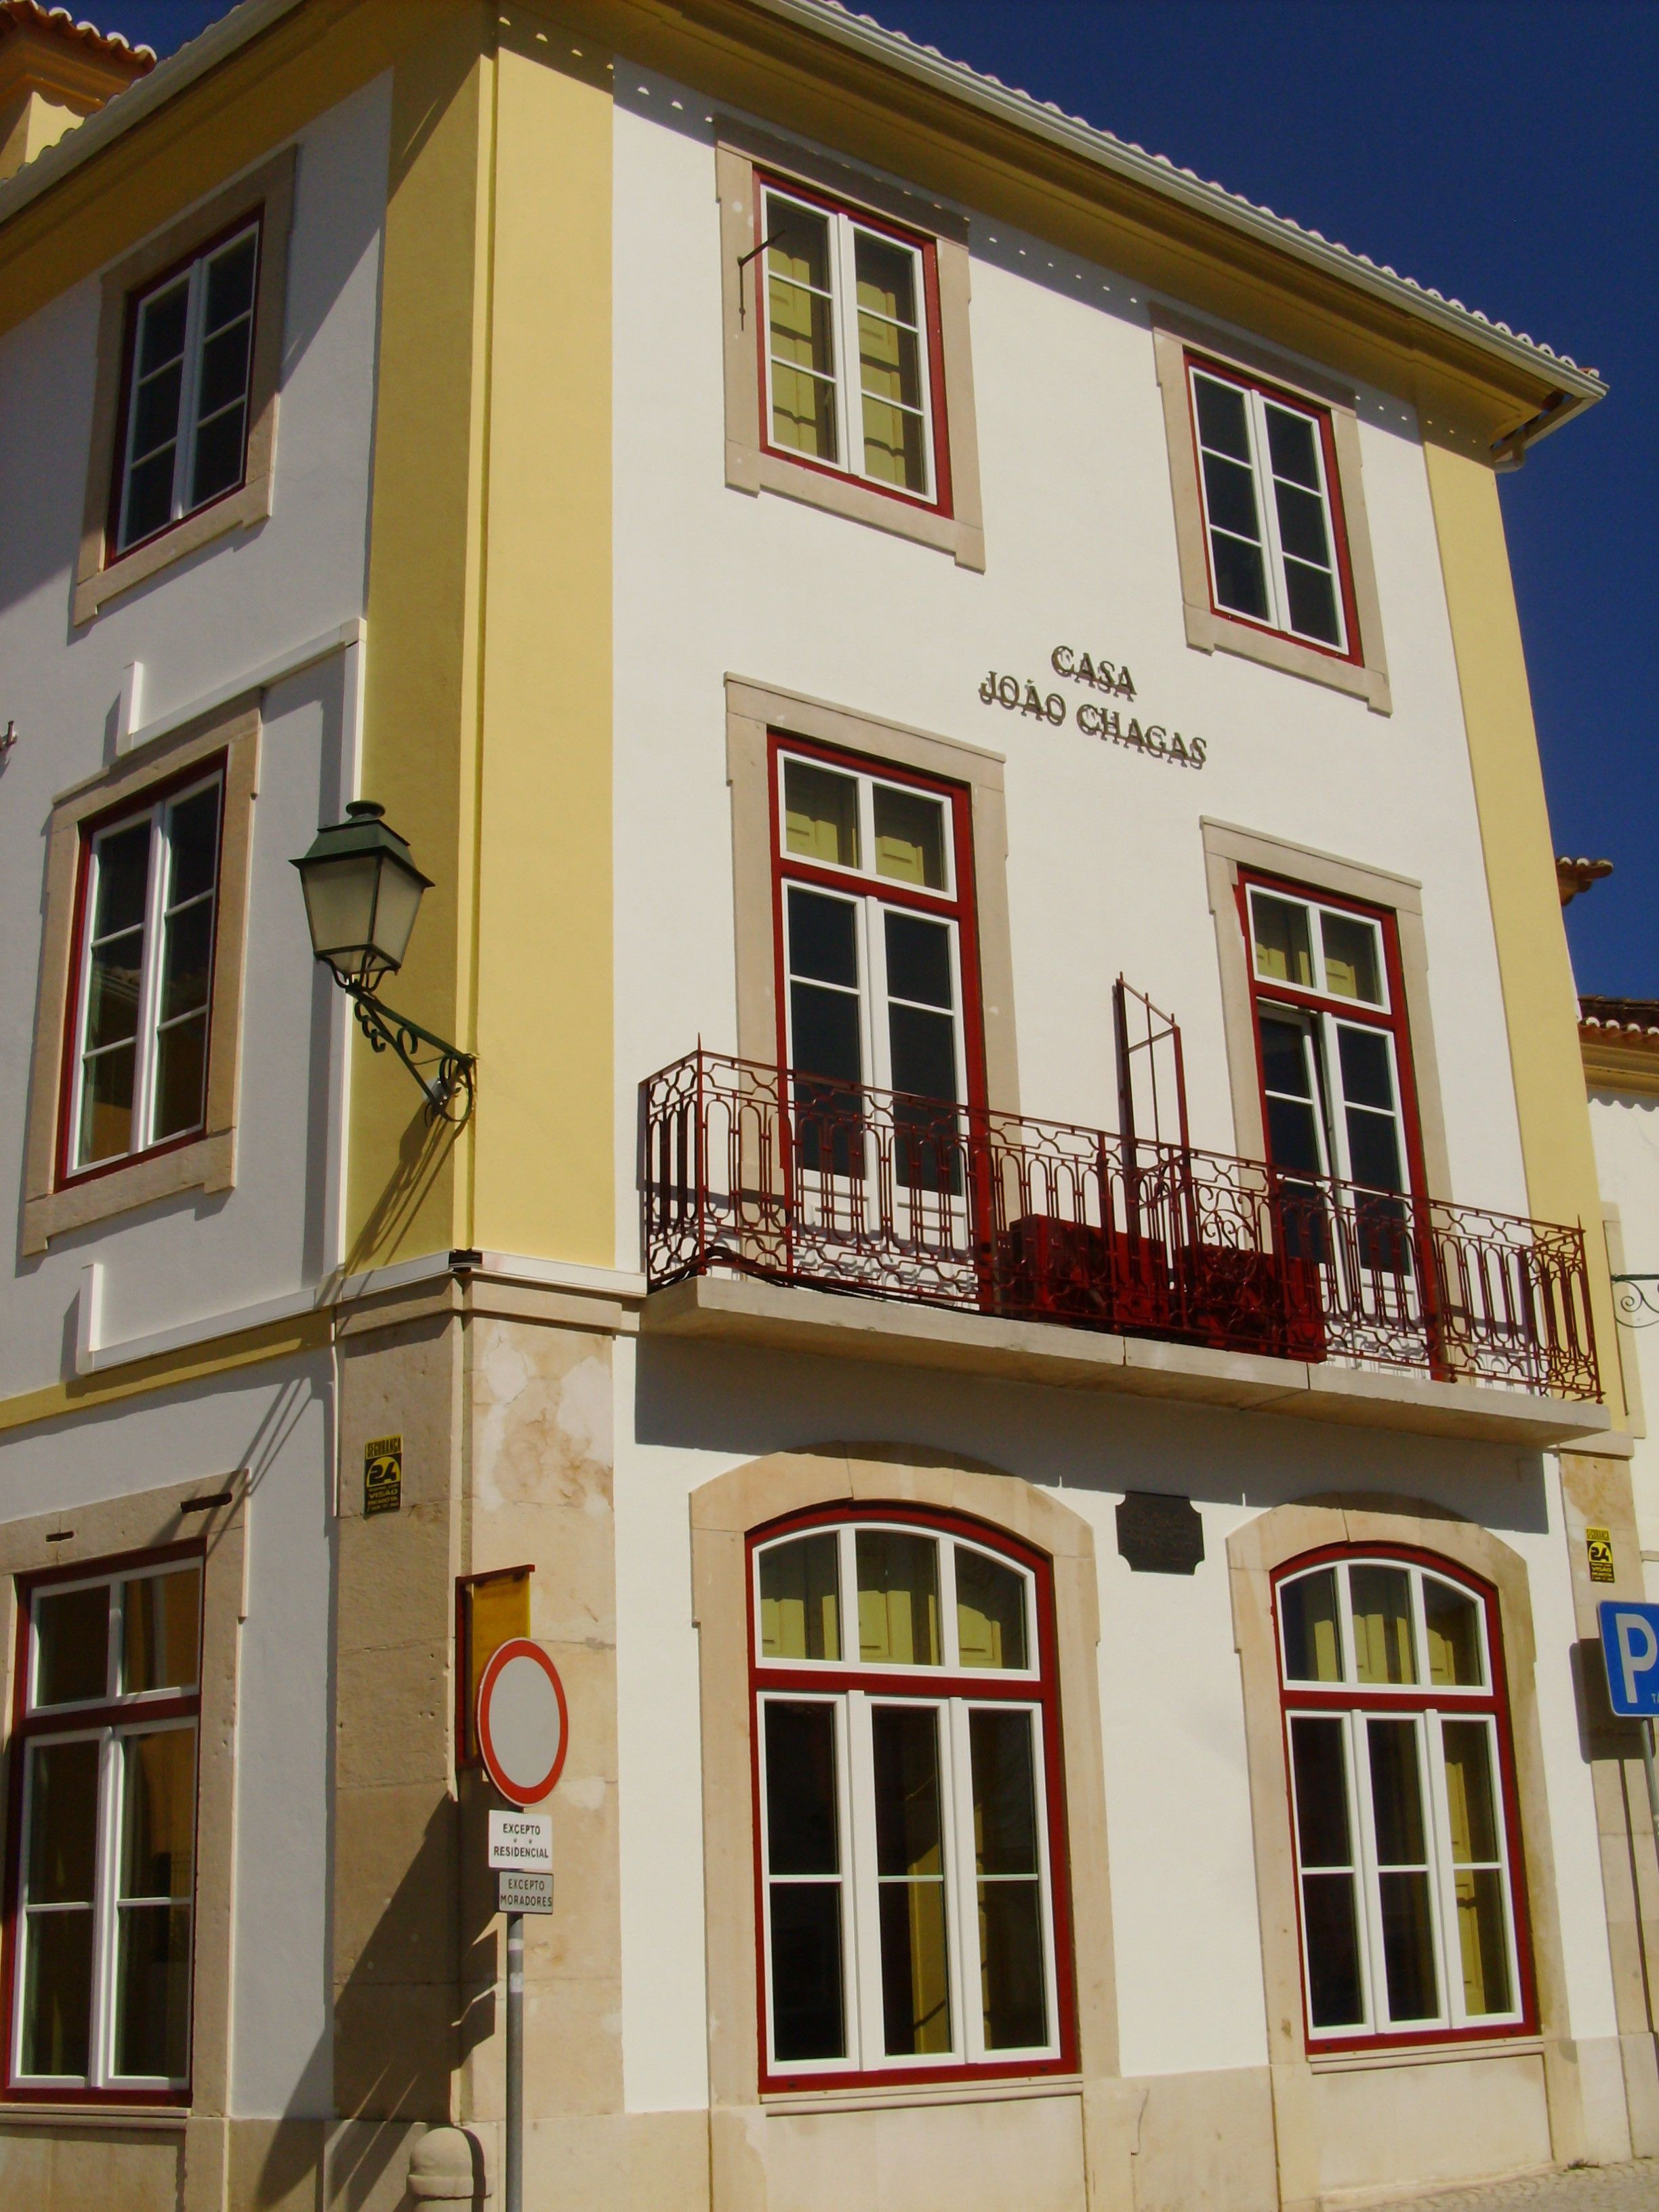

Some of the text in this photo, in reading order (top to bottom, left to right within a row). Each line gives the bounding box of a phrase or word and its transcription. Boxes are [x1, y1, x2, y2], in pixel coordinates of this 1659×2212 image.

[1051, 646, 1138, 699] CASA
[979, 670, 1208, 766] JOÃO CHAGAS
[369, 1461, 397, 1486] 24
[1591, 1546, 1610, 1562] 24
[1615, 1612, 1658, 1704] P
[502, 1823, 541, 1835] EXCEPTO
[493, 1845, 549, 1858] RESIDENCIAL
[508, 1878, 545, 1891] EXCEPTO
[500, 1894, 553, 1907] MORADORES
